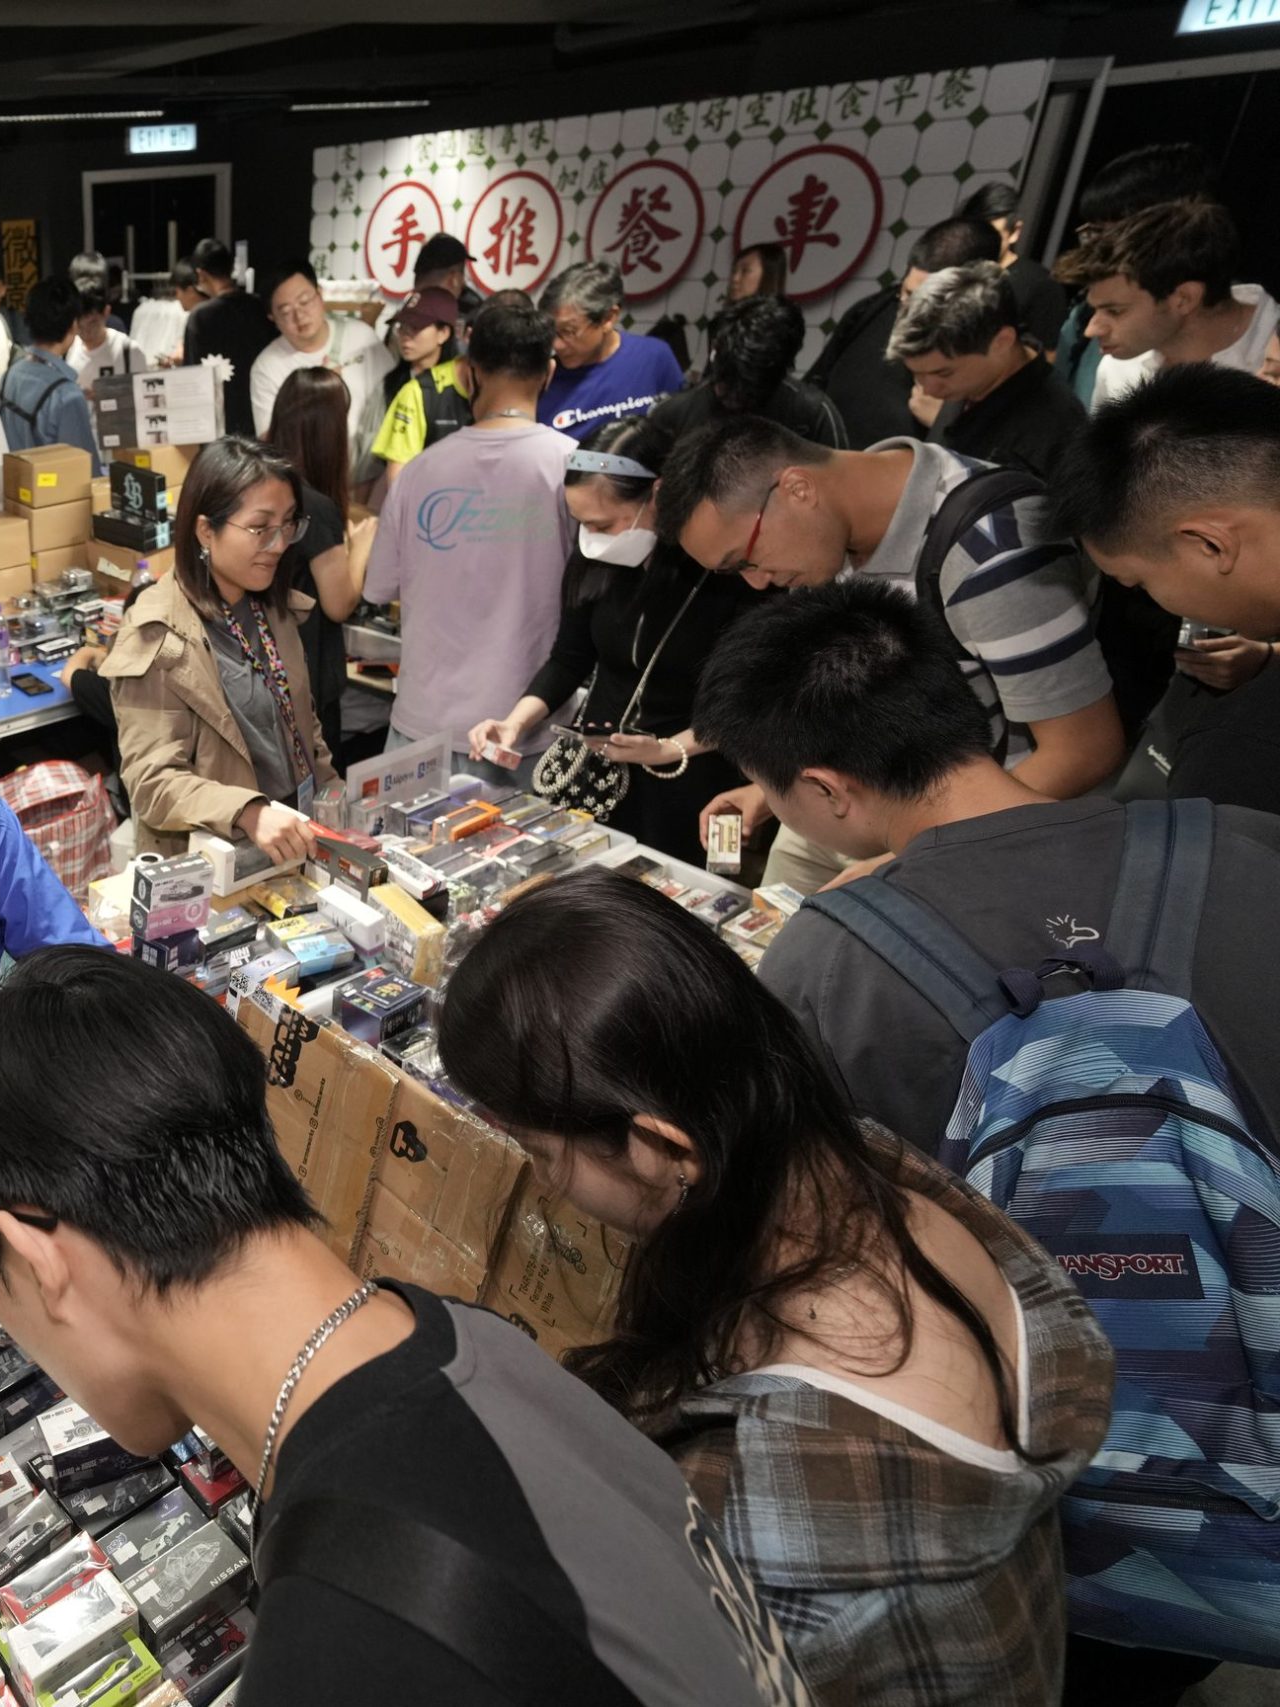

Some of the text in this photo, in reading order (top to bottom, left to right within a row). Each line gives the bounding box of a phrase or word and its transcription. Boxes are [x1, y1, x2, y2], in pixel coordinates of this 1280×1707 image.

[381, 173, 840, 277] 手推餐車
[553, 395, 655, 429] Champion
[209, 1557, 249, 1588] NISSAN
